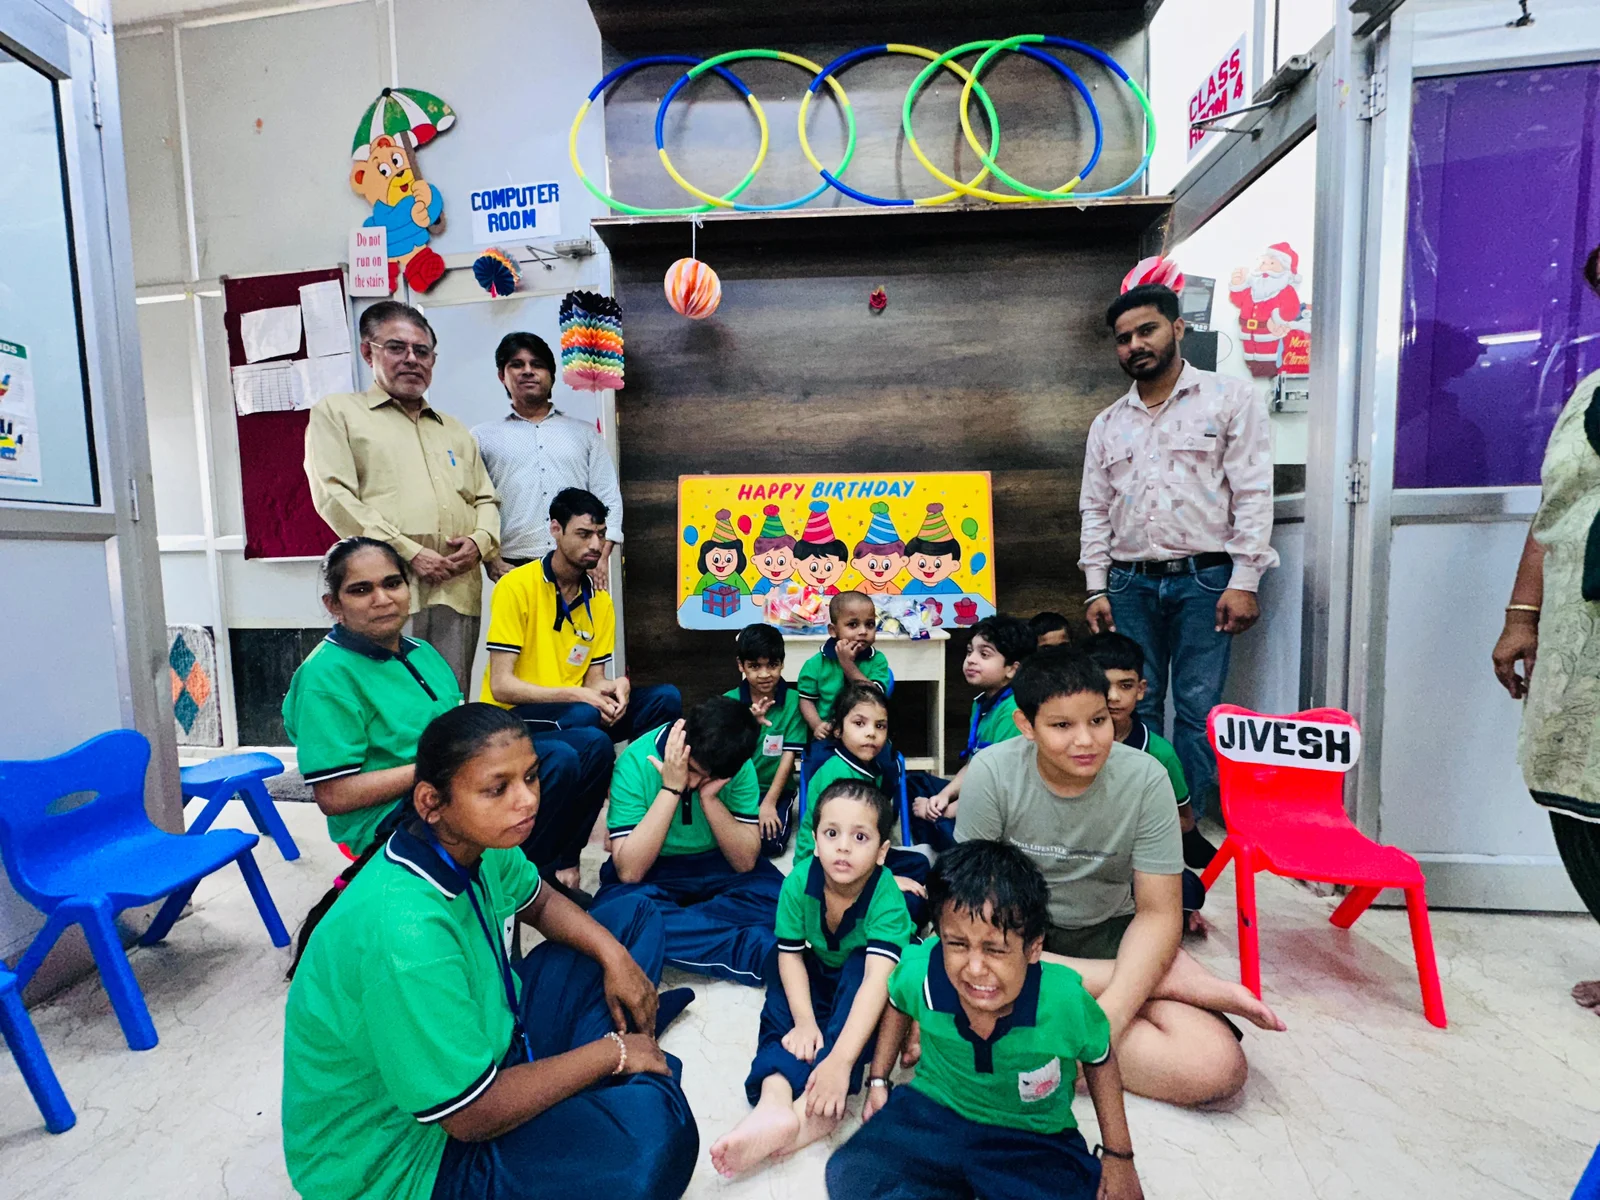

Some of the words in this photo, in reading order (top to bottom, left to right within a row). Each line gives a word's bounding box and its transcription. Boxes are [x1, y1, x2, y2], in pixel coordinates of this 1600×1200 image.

[1189, 48, 1240, 122] CLASS
[471, 183, 559, 211] COMPUTER
[487, 208, 536, 233] ROOM
[356, 232, 367, 247] Do
[369, 234, 381, 247] not
[356, 256, 370, 267] run
[372, 256, 382, 267] on
[355, 274, 365, 288] the
[366, 273, 385, 288] stairs
[737, 482, 805, 500] HAPPY
[811, 480, 915, 501] BIRTHDAY
[1218, 717, 1351, 764] JIVESH
[1030, 843, 1068, 855] LIFESTYLE
